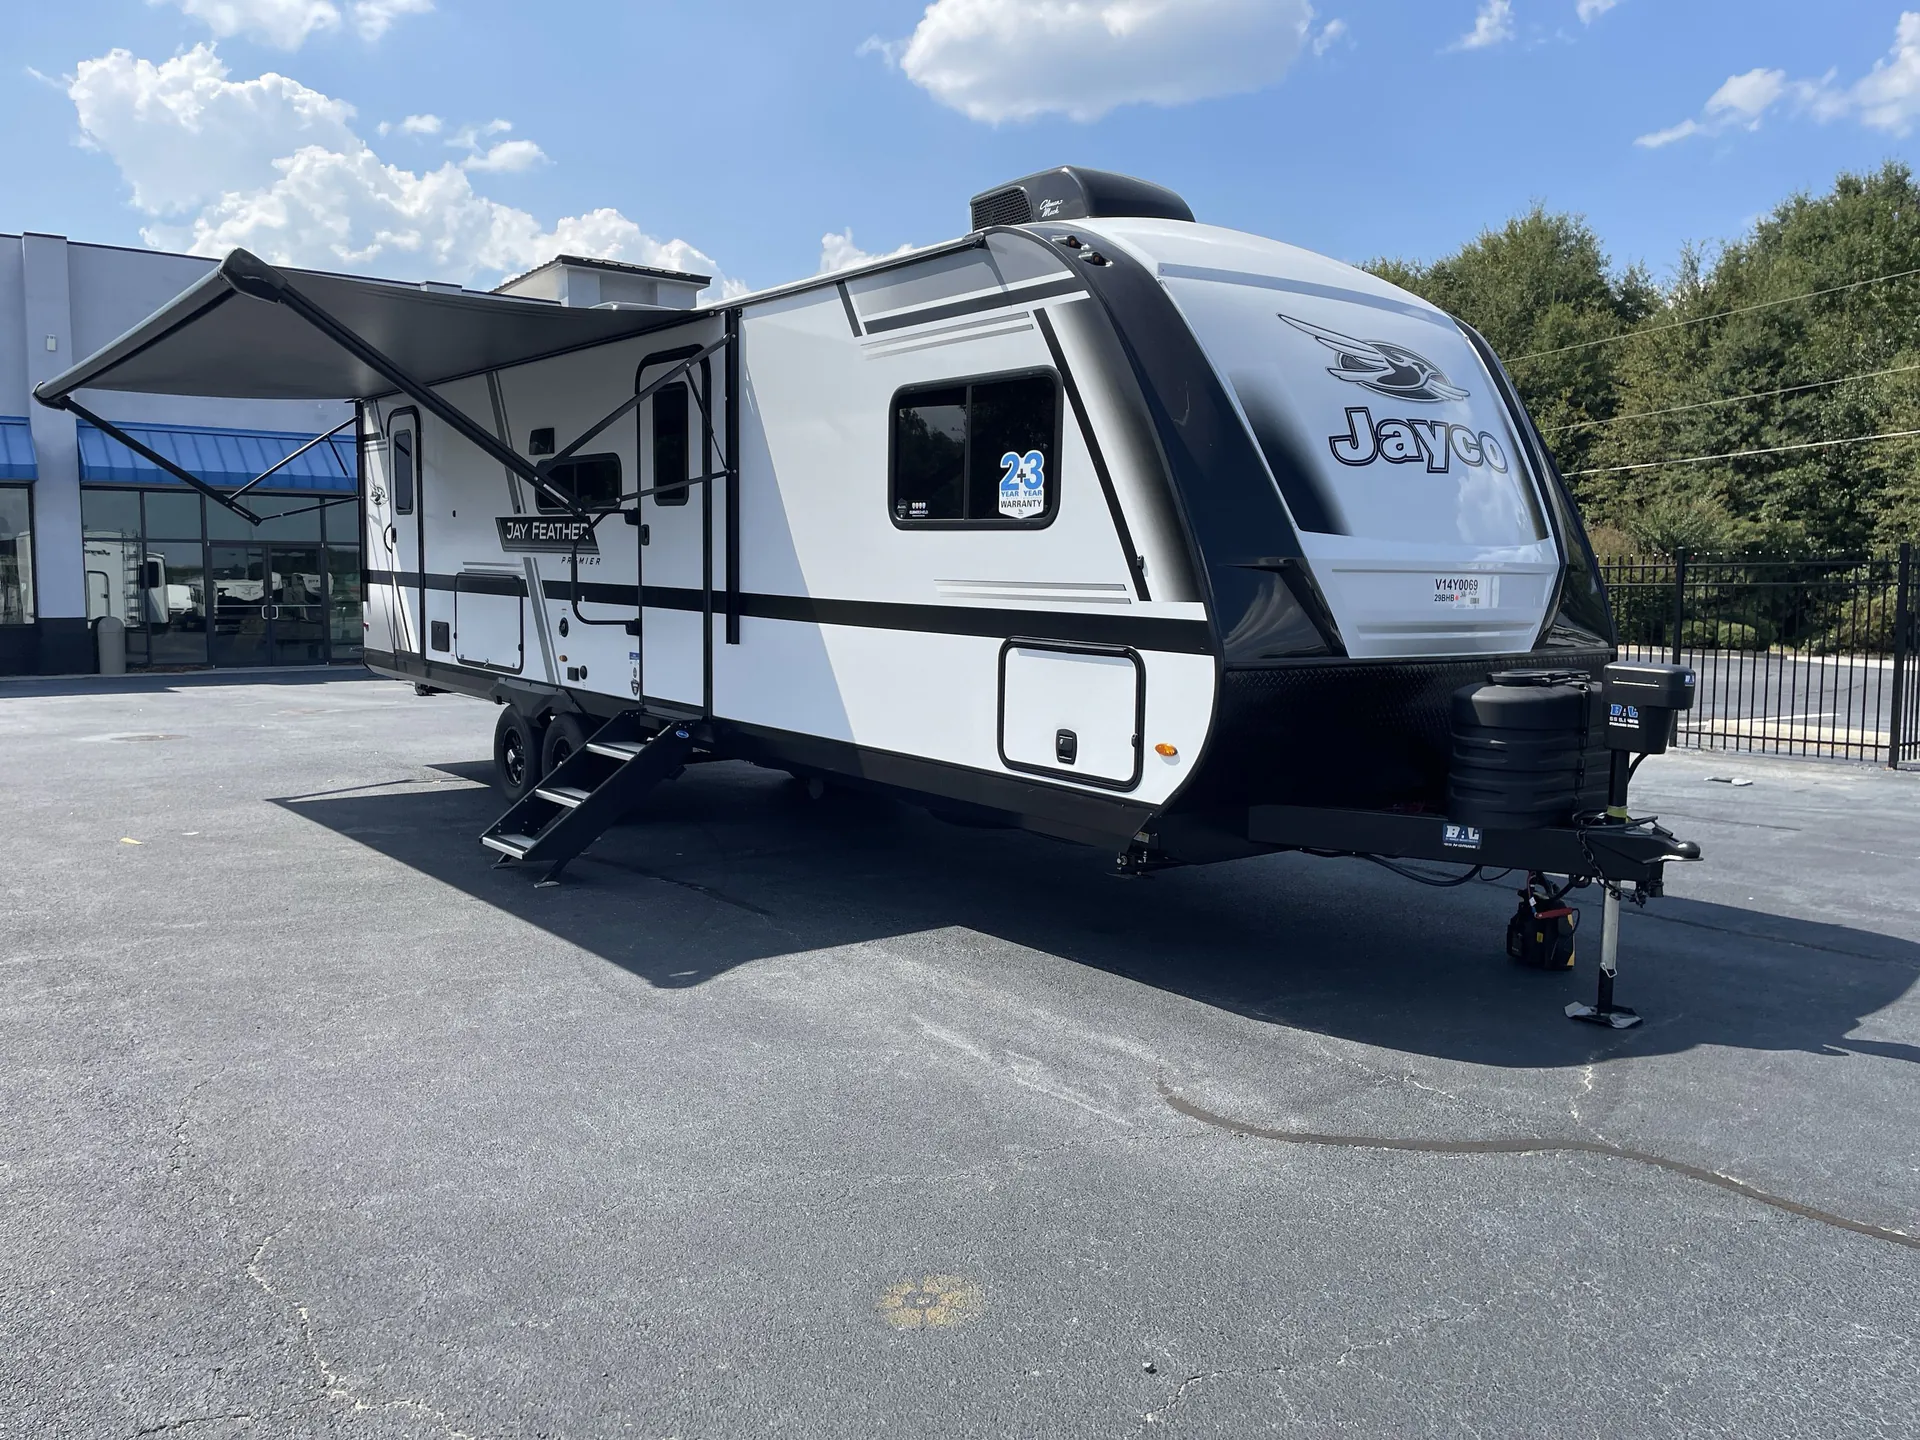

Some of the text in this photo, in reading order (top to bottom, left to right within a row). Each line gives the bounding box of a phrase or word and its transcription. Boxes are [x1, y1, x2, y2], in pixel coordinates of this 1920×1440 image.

[1329, 406, 1508, 474] Jayco
[1001, 500, 1042, 508] WARRANTY
[506, 522, 528, 539] JAY
[561, 556, 600, 565] PRMIER
[1435, 579, 1478, 590] V14Y0069
[1445, 825, 1479, 840] BAL
